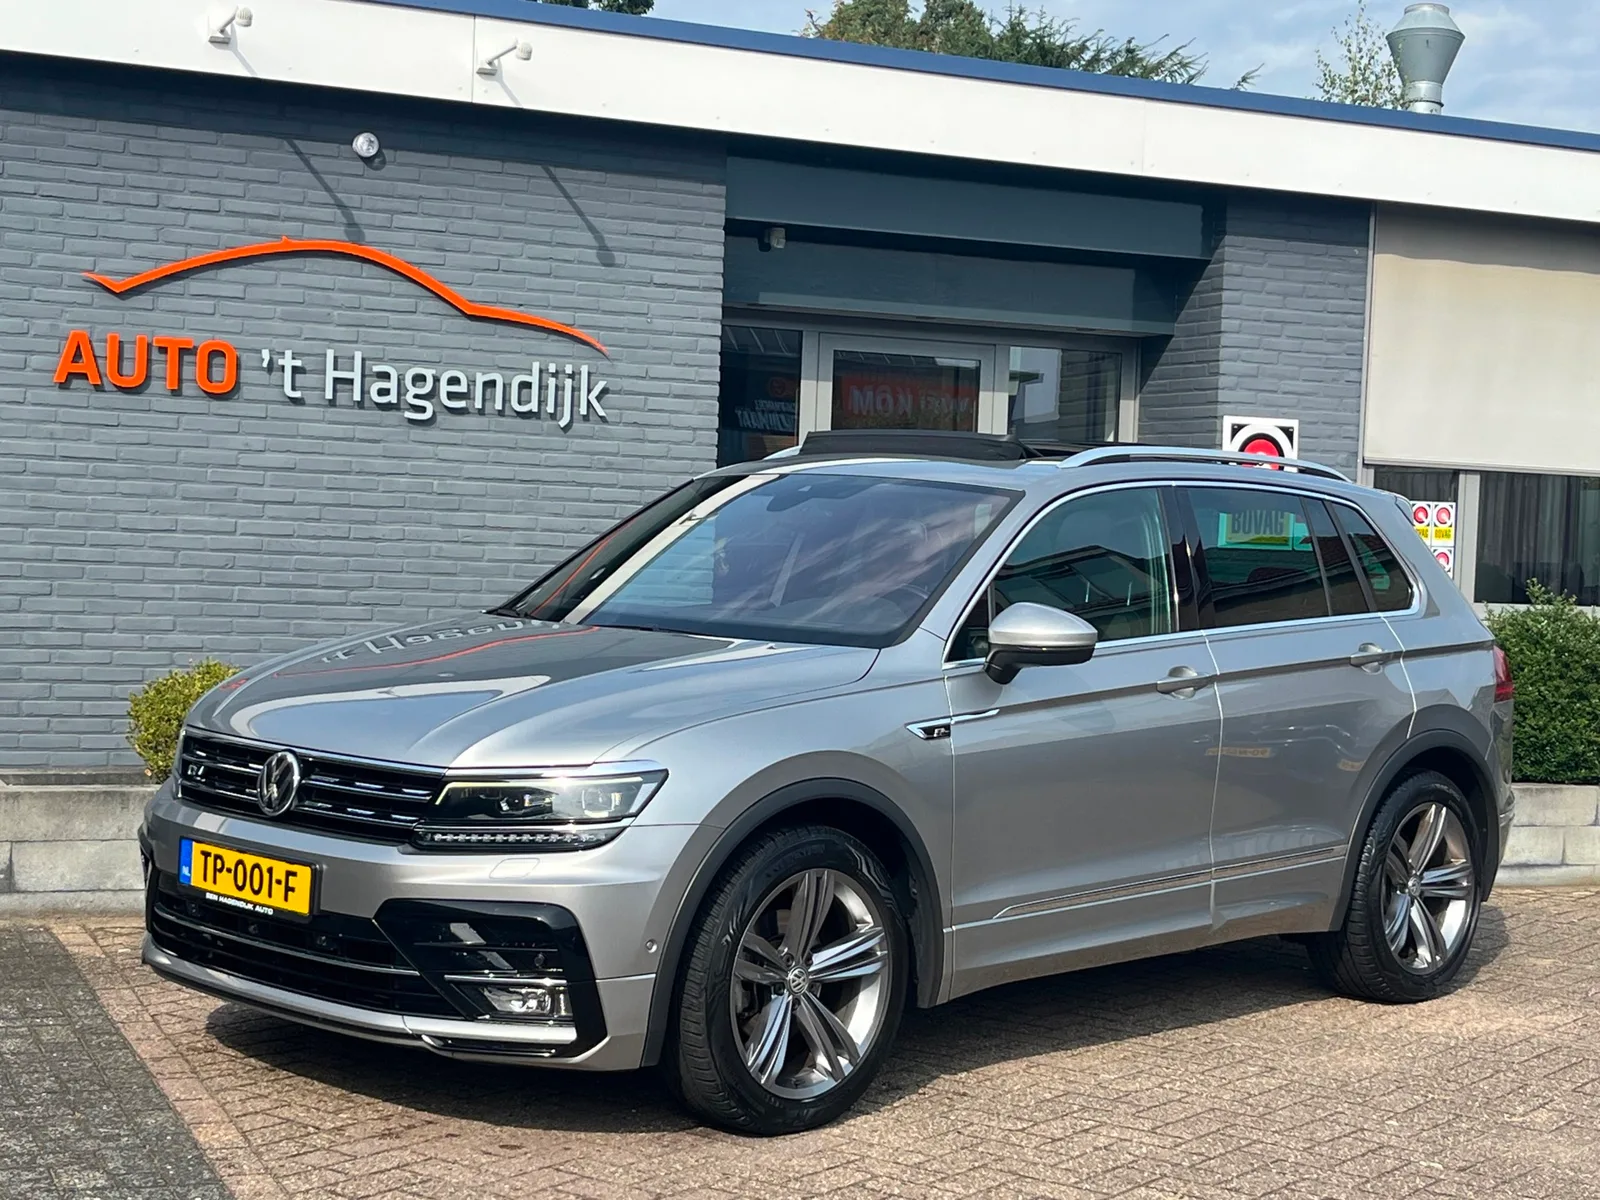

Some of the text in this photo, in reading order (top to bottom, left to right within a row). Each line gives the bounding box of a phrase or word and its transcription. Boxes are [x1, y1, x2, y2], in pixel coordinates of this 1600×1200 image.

[53, 329, 608, 429] AUTO 't Hagendijk
[1231, 510, 1285, 536] BOVAG
[200, 849, 298, 903] TP-001-F
[254, 904, 274, 915] AUTO
